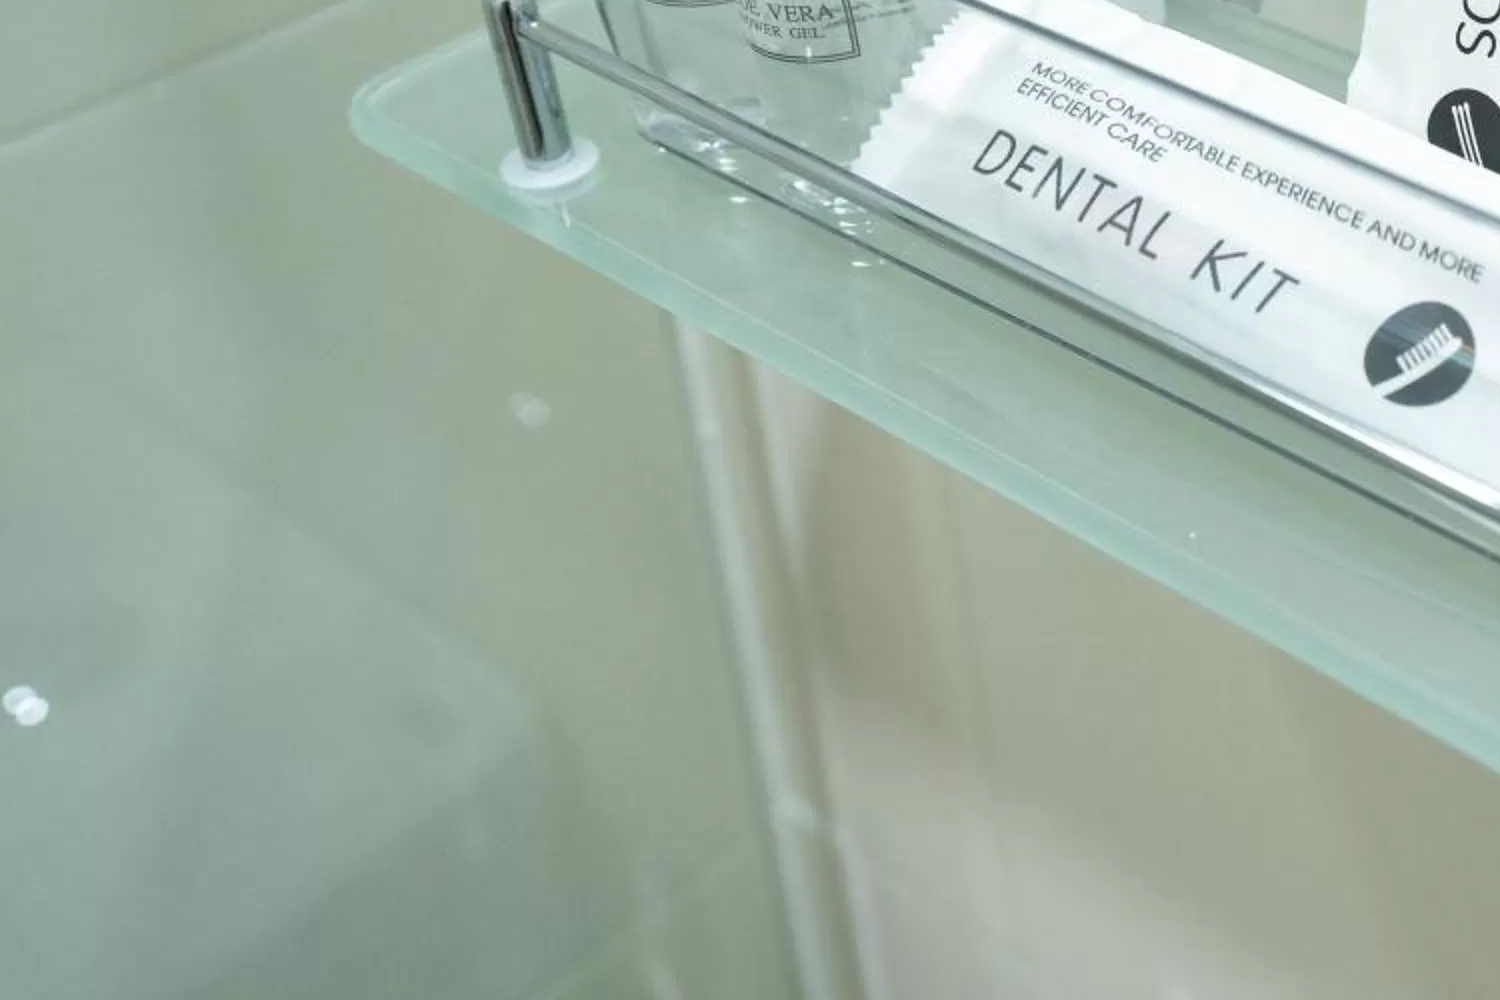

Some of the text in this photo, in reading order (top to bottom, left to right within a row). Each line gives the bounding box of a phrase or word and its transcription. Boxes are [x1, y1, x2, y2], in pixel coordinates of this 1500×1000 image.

[767, 3, 834, 23] VERA
[789, 27, 826, 39] GEL
[1016, 77, 1169, 164] EFFICIENT CARE
[1032, 61, 1487, 285] MORE COMFORTABLE EXPERIENCE AND MORE
[971, 129, 1301, 313] DENTAL KIT
